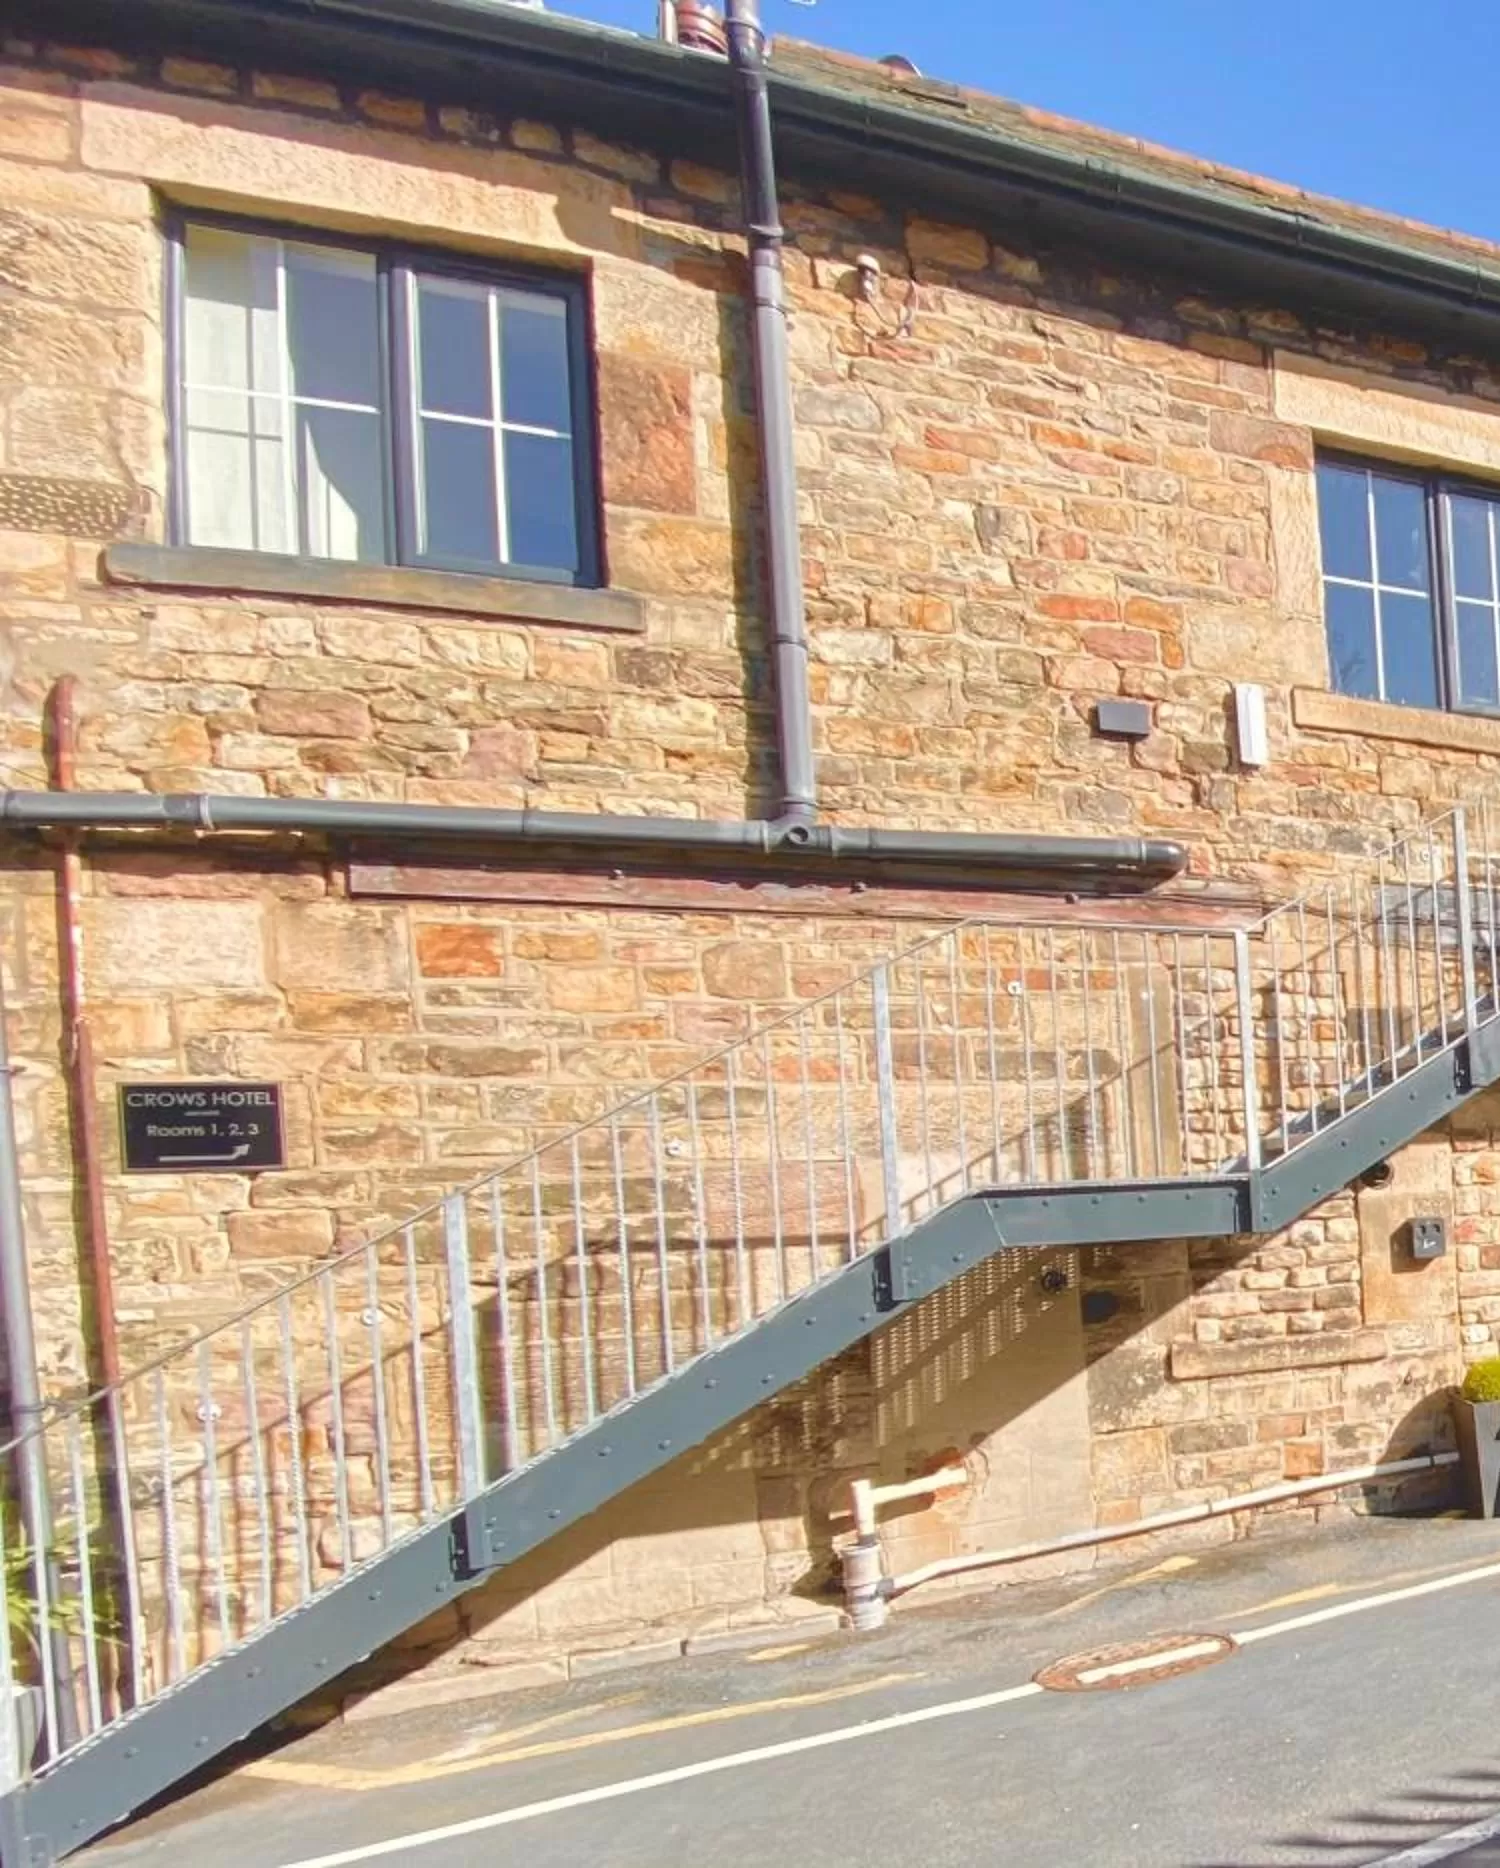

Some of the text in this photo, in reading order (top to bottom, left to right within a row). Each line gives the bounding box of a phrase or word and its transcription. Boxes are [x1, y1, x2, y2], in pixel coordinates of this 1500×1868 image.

[127, 1091, 276, 1107] CROWS HOTEL
[147, 1124, 205, 1137] Rooms
[248, 1123, 260, 1136] 3
